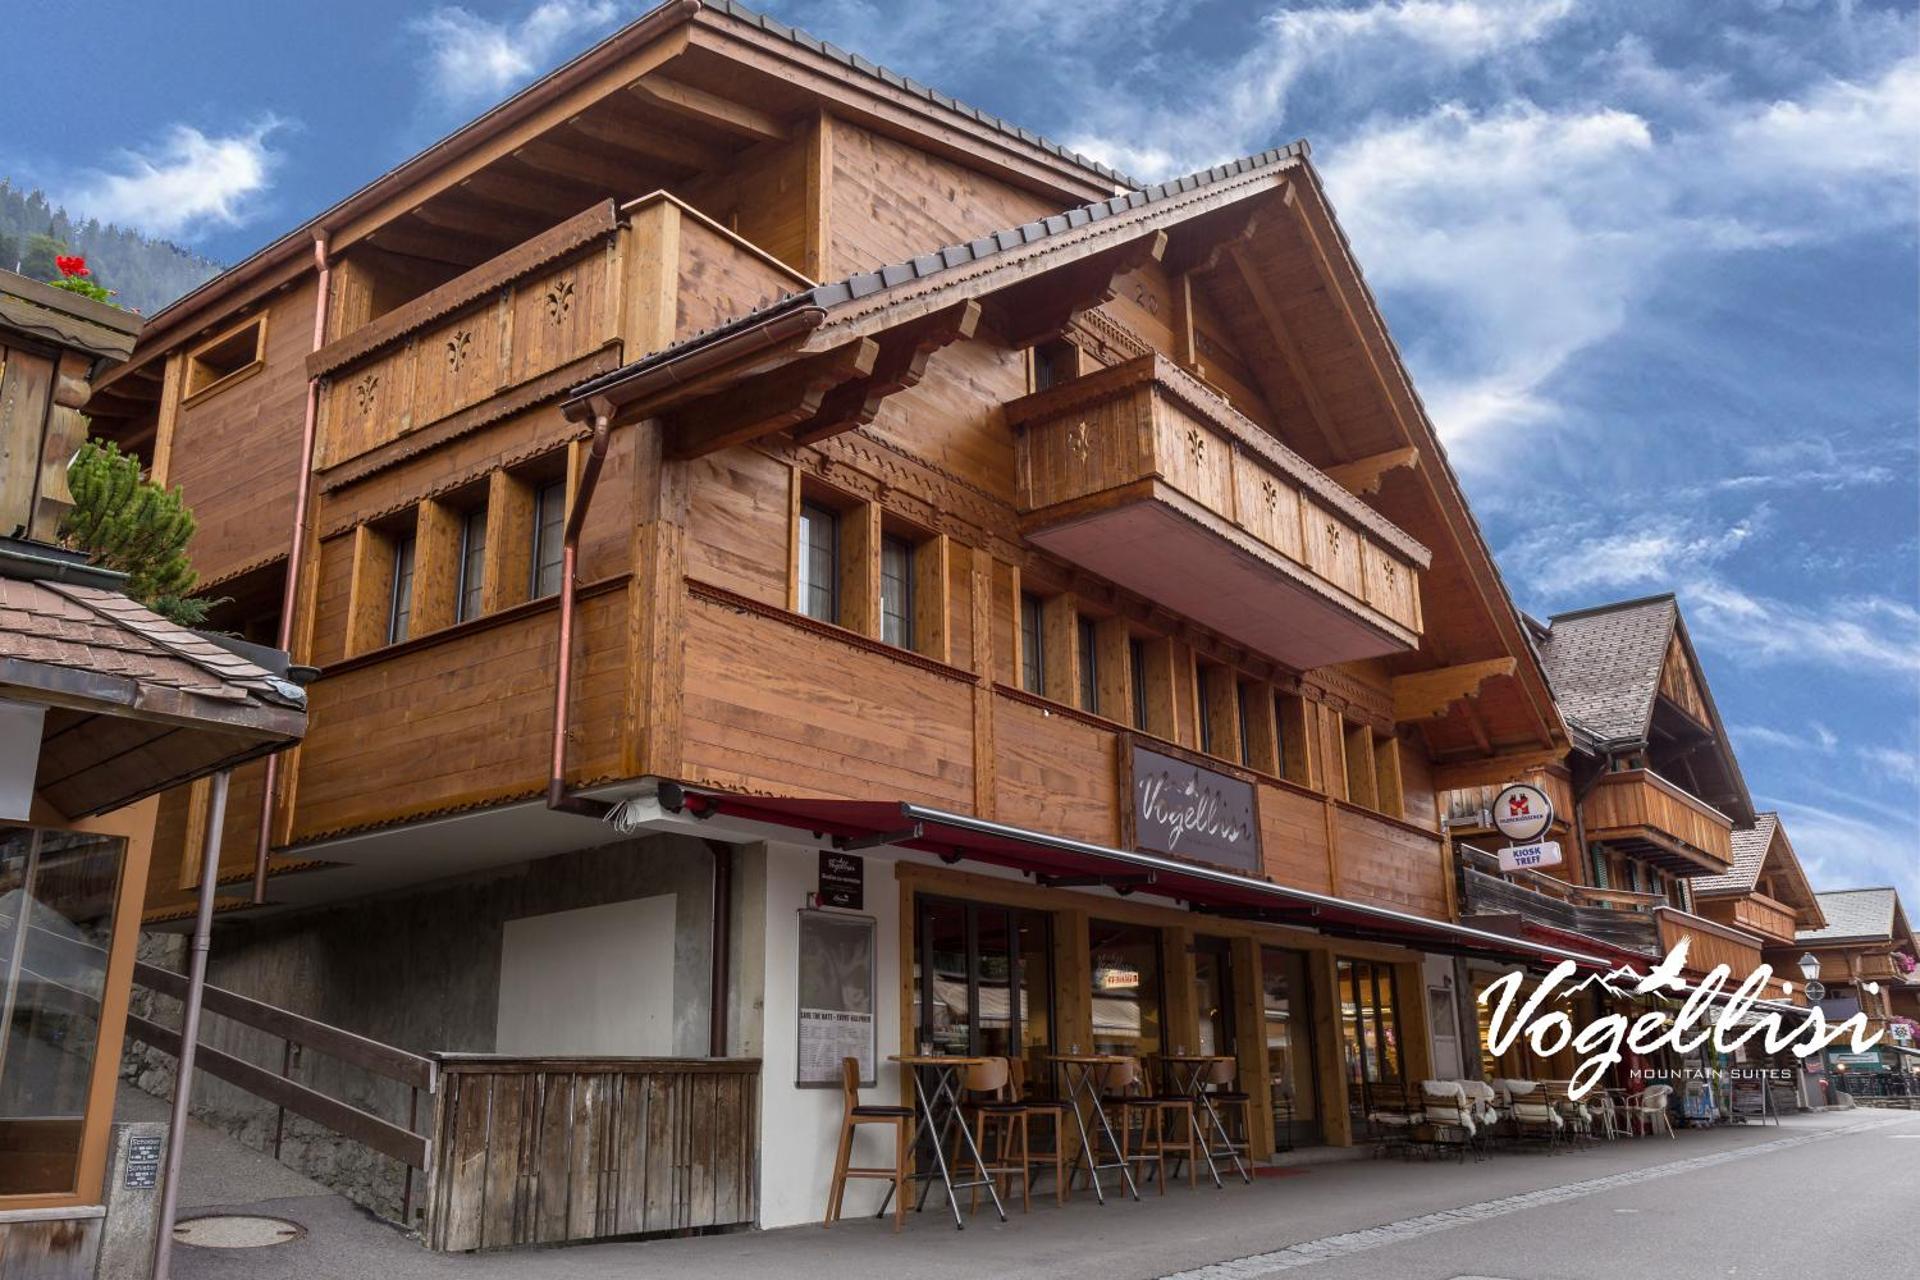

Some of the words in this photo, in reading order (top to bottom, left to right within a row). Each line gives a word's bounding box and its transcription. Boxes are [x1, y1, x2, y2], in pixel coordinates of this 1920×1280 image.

[1139, 770, 1252, 851] Vogellisi
[1513, 846, 1541, 858] KIOSK
[1515, 856, 1541, 866] TREFF
